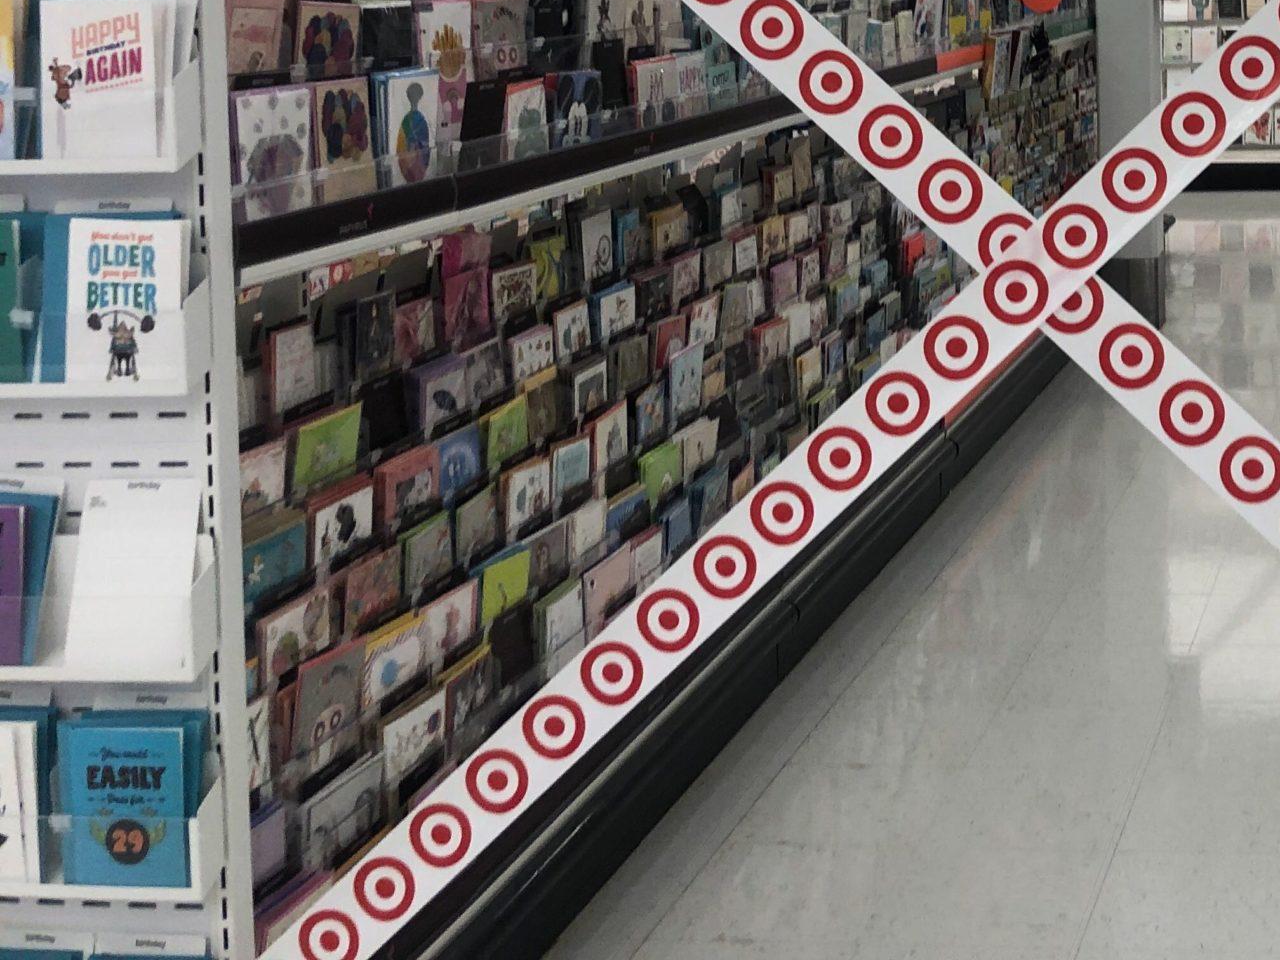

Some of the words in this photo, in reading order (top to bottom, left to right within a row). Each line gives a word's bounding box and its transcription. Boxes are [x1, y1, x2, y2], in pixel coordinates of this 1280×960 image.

[71, 12, 142, 59] HAPPY
[86, 41, 126, 56] BIRTHDAY
[85, 47, 142, 86] AGAIN
[111, 231, 136, 241] don't
[88, 244, 156, 278] OLDER
[87, 281, 157, 317] BETTER
[86, 765, 167, 790] EASILY
[112, 825, 144, 853] 29
